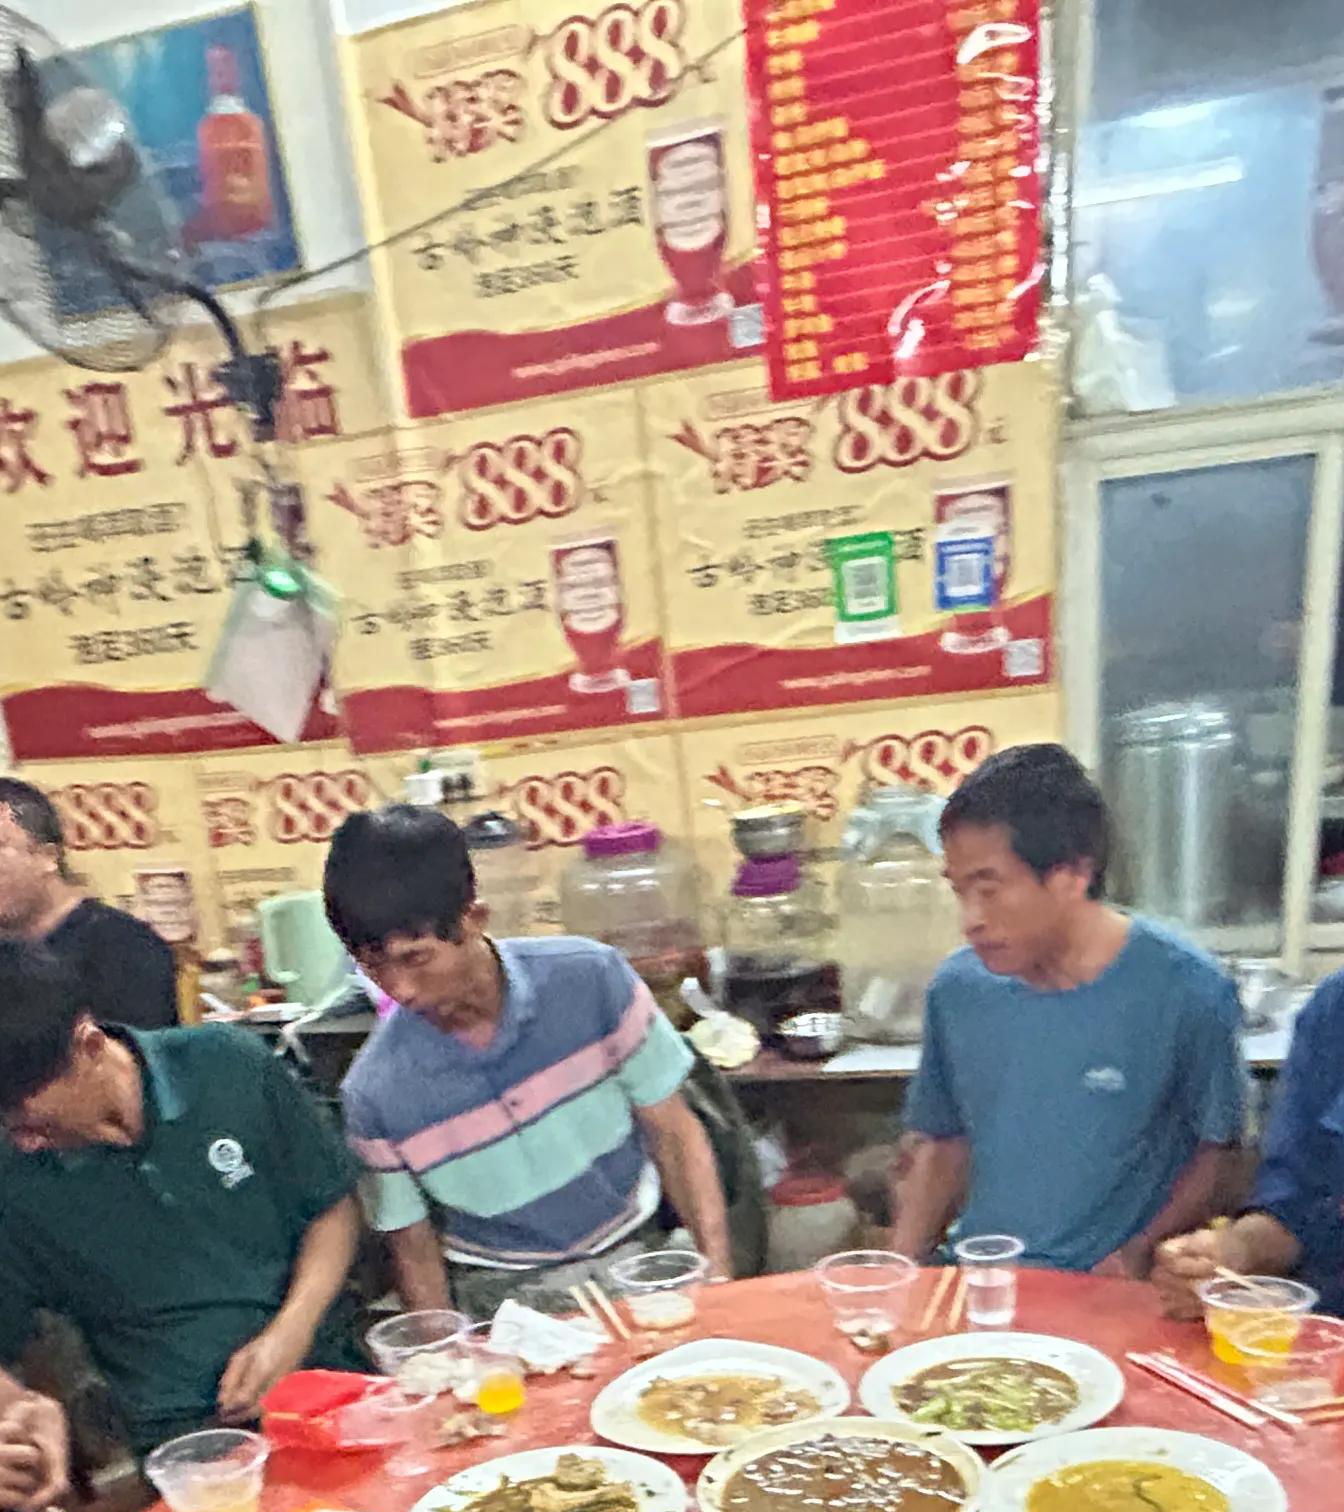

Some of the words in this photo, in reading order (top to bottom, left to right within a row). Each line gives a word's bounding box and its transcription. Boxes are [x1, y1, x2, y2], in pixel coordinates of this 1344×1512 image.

[544, 2, 684, 130] 888
[834, 370, 984, 474] 888
[461, 427, 584, 532] 888
